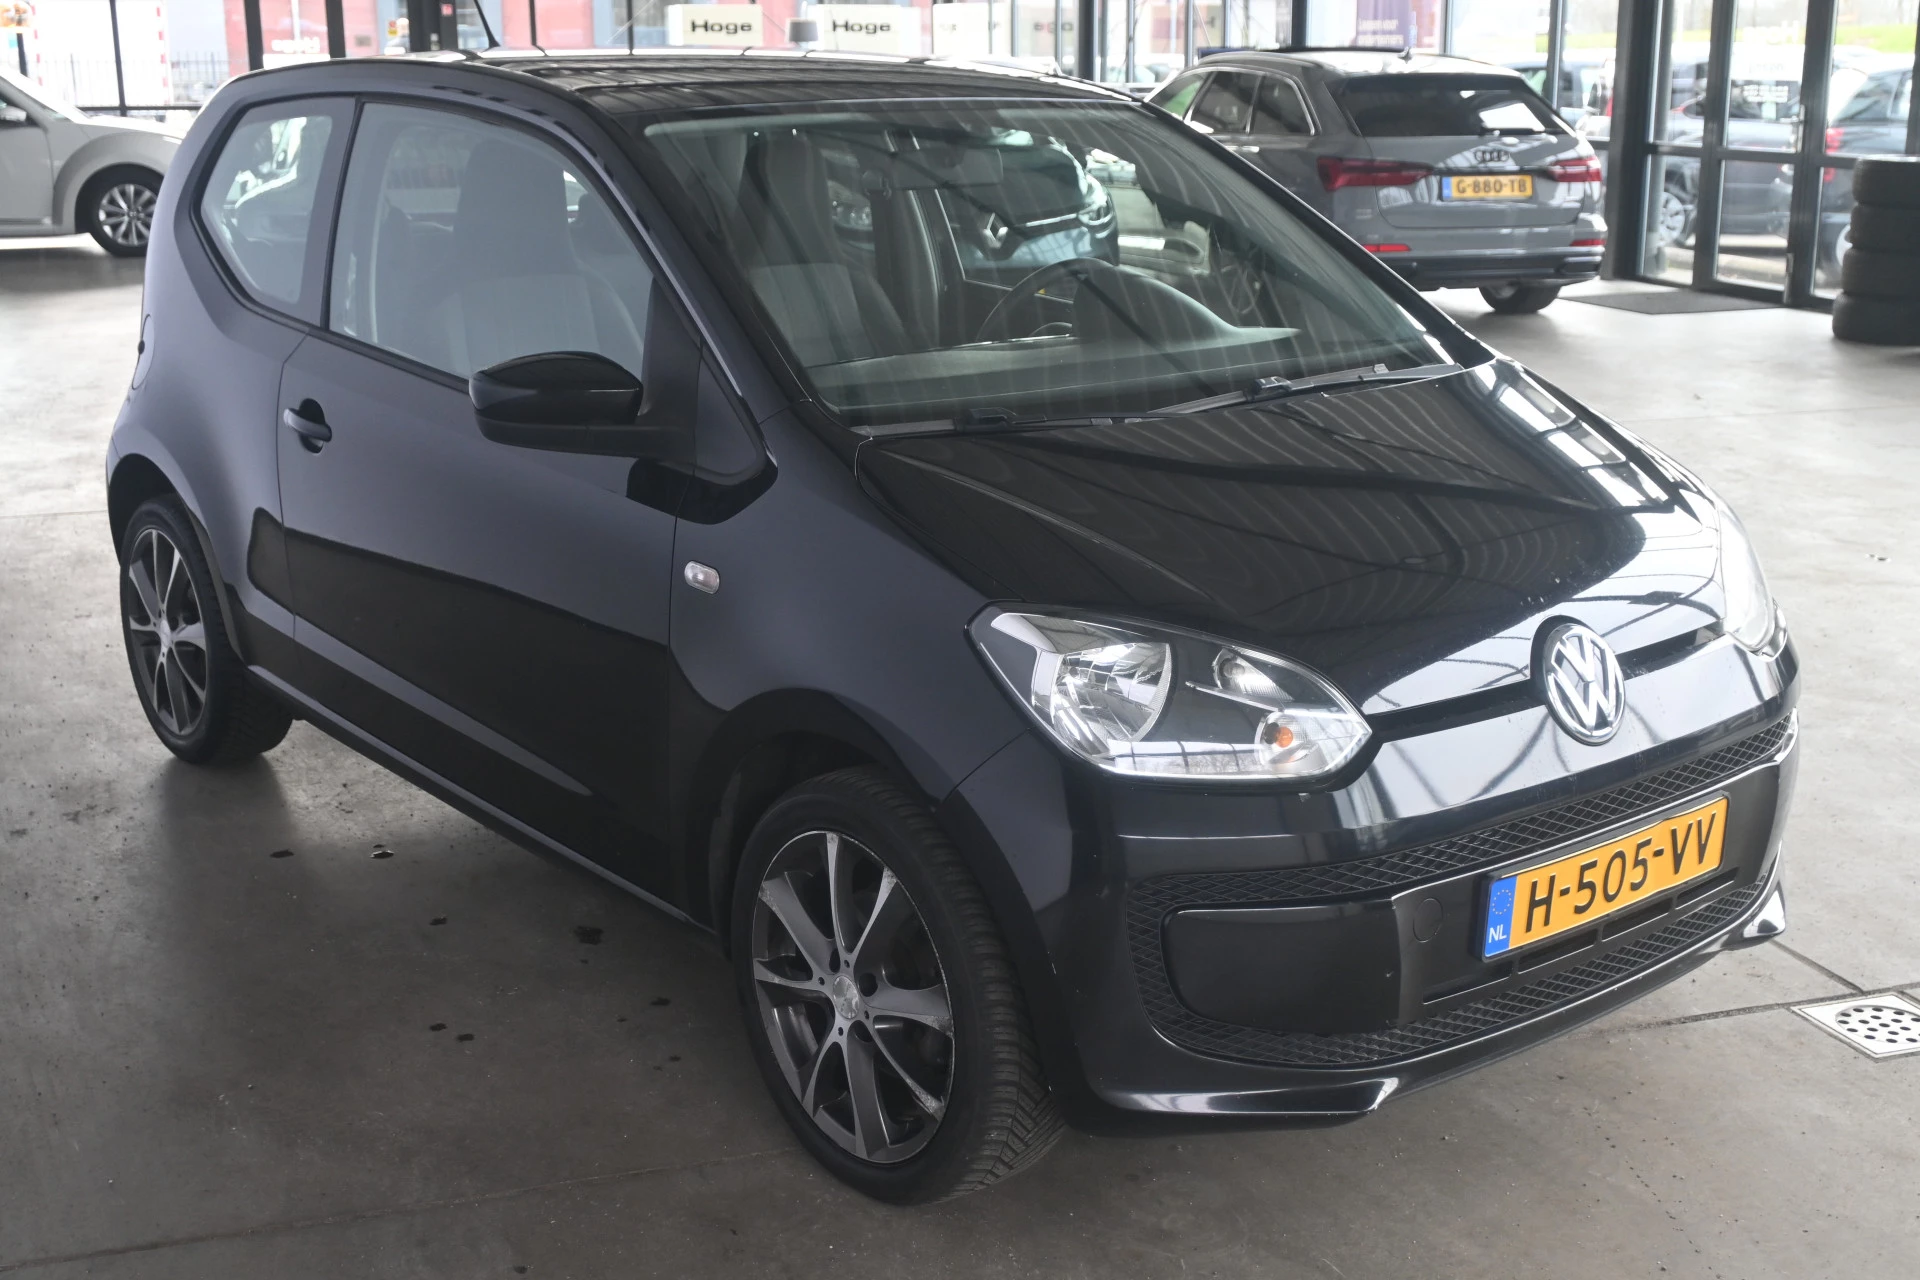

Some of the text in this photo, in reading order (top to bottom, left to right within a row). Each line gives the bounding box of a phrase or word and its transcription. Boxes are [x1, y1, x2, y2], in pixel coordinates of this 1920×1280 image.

[691, 20, 752, 35] Hoge
[832, 20, 891, 35] Hoge
[1456, 178, 1527, 194] G-880-TB
[1525, 812, 1717, 933] H-505-VV
[1488, 923, 1507, 944] NL
